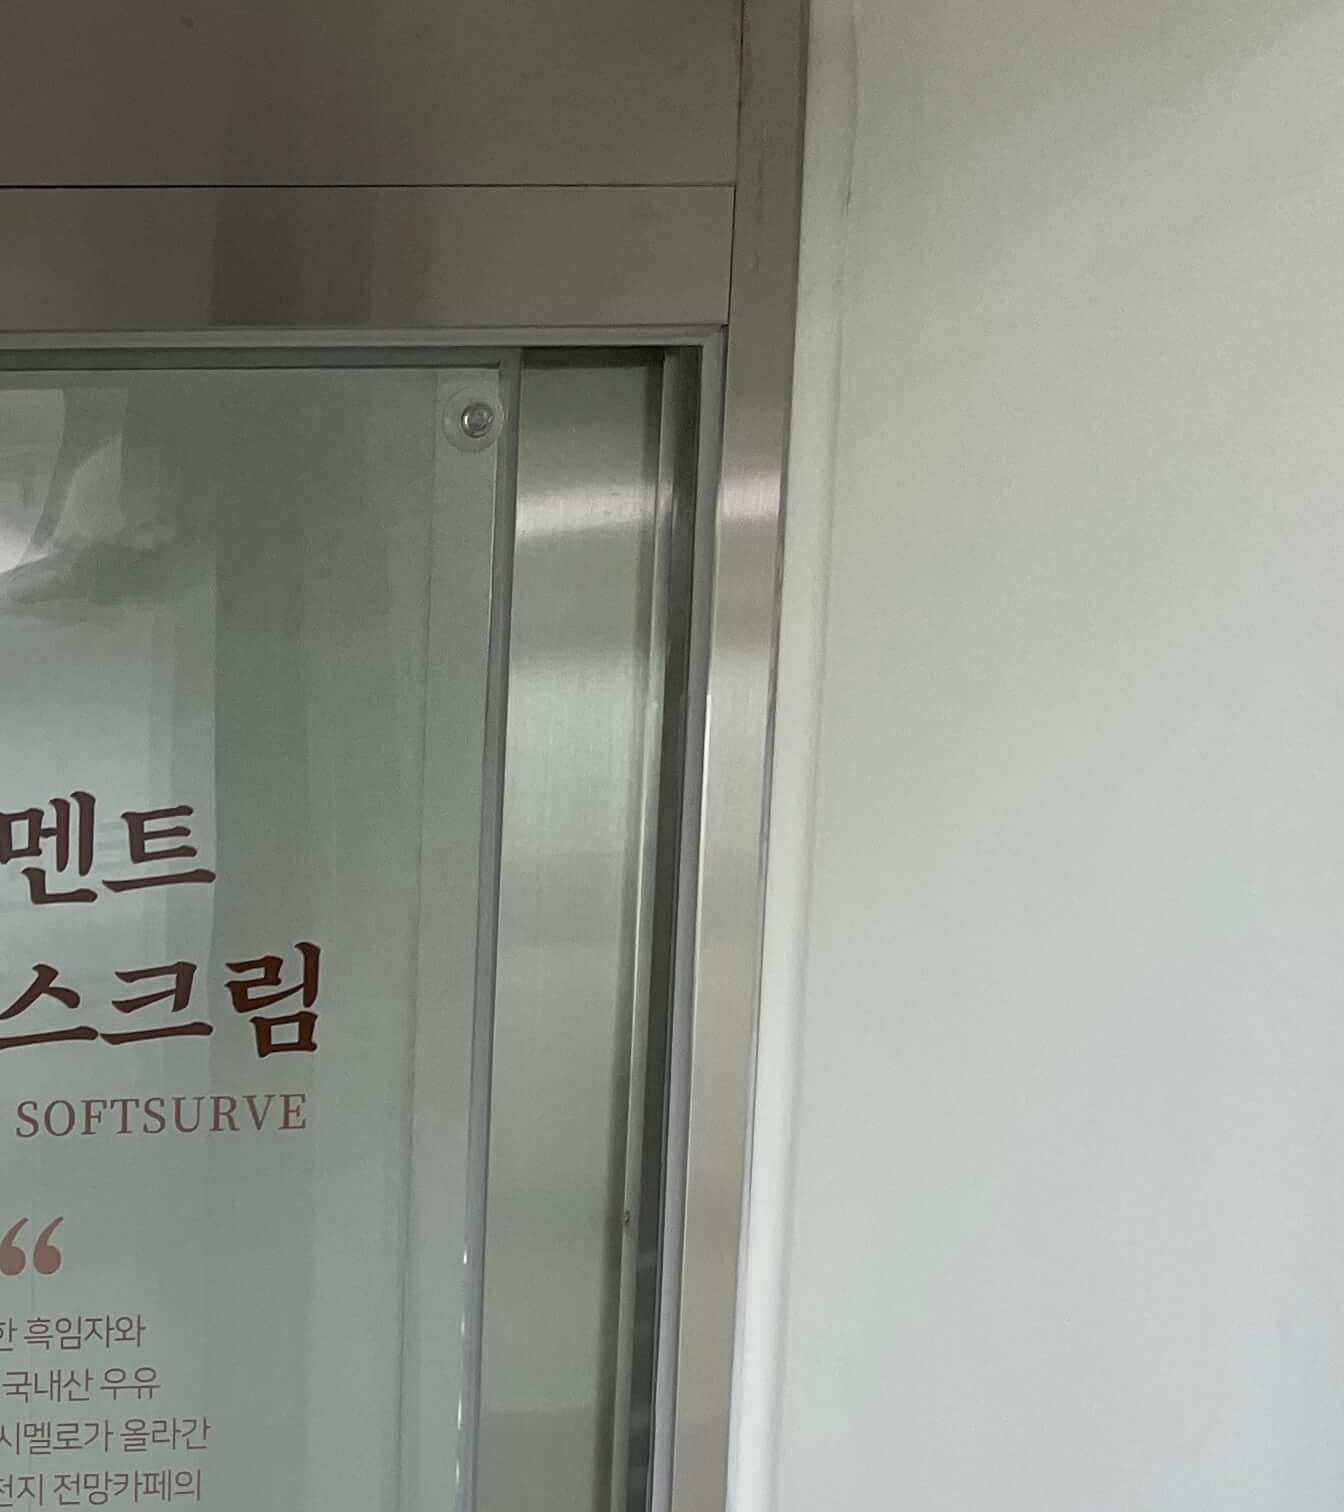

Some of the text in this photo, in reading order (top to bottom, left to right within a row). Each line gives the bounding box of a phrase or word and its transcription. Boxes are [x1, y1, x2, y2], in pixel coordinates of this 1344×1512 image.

[15, 1093, 307, 1139] SOFTSURVE
[23, 1313, 146, 1351] 흑임자와
[2, 1368, 94, 1403] 국내산
[99, 1366, 161, 1400] 우유
[119, 1415, 211, 1452] 올라간
[52, 1469, 202, 1507] 전망카페의
